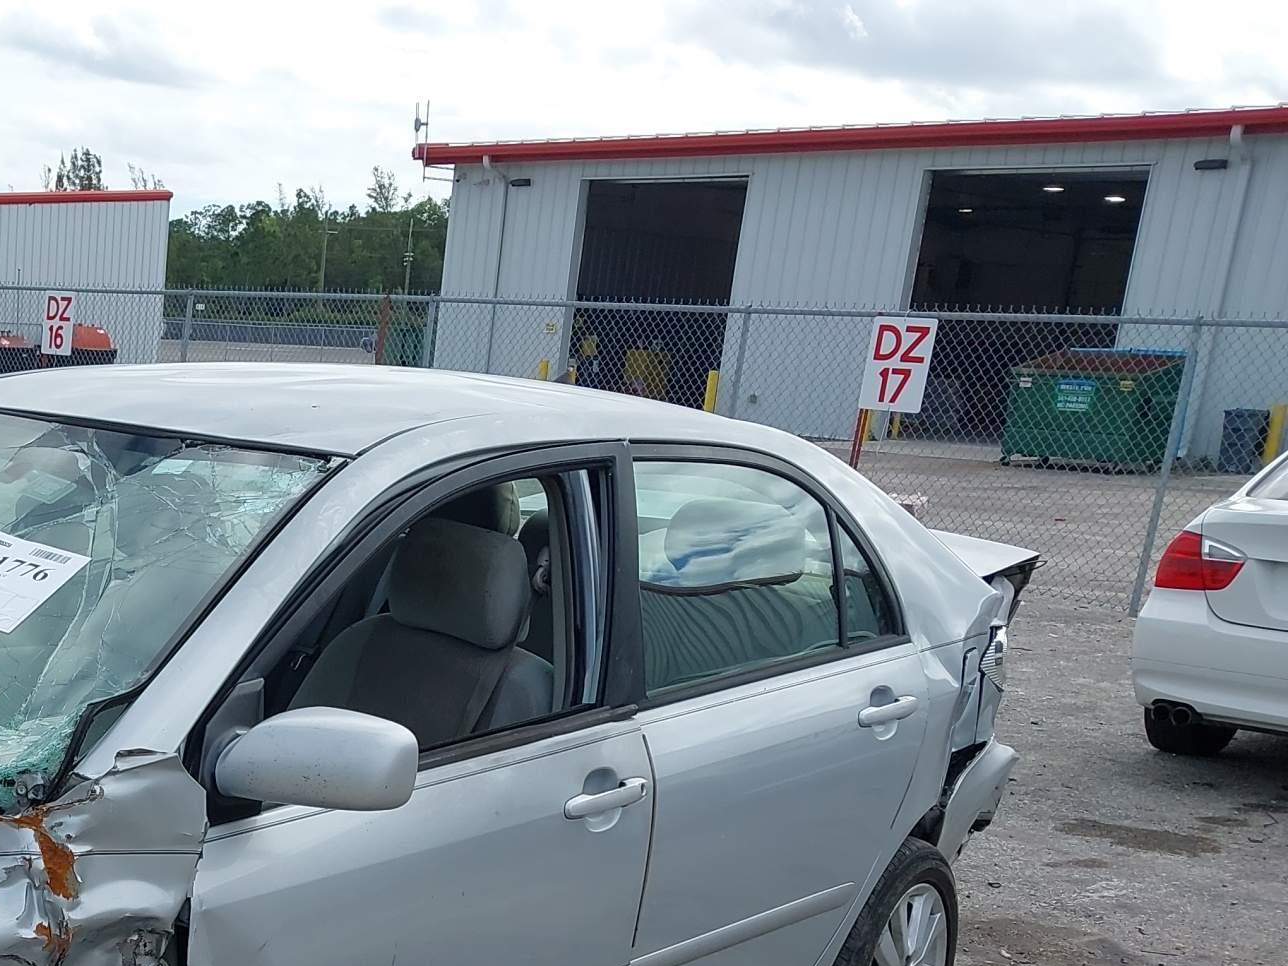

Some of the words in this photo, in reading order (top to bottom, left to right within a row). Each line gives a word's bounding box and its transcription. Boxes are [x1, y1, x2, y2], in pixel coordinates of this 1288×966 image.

[46, 295, 73, 322] DZ
[48, 324, 64, 350] 16
[872, 324, 931, 364] DZ
[878, 367, 912, 404] 17
